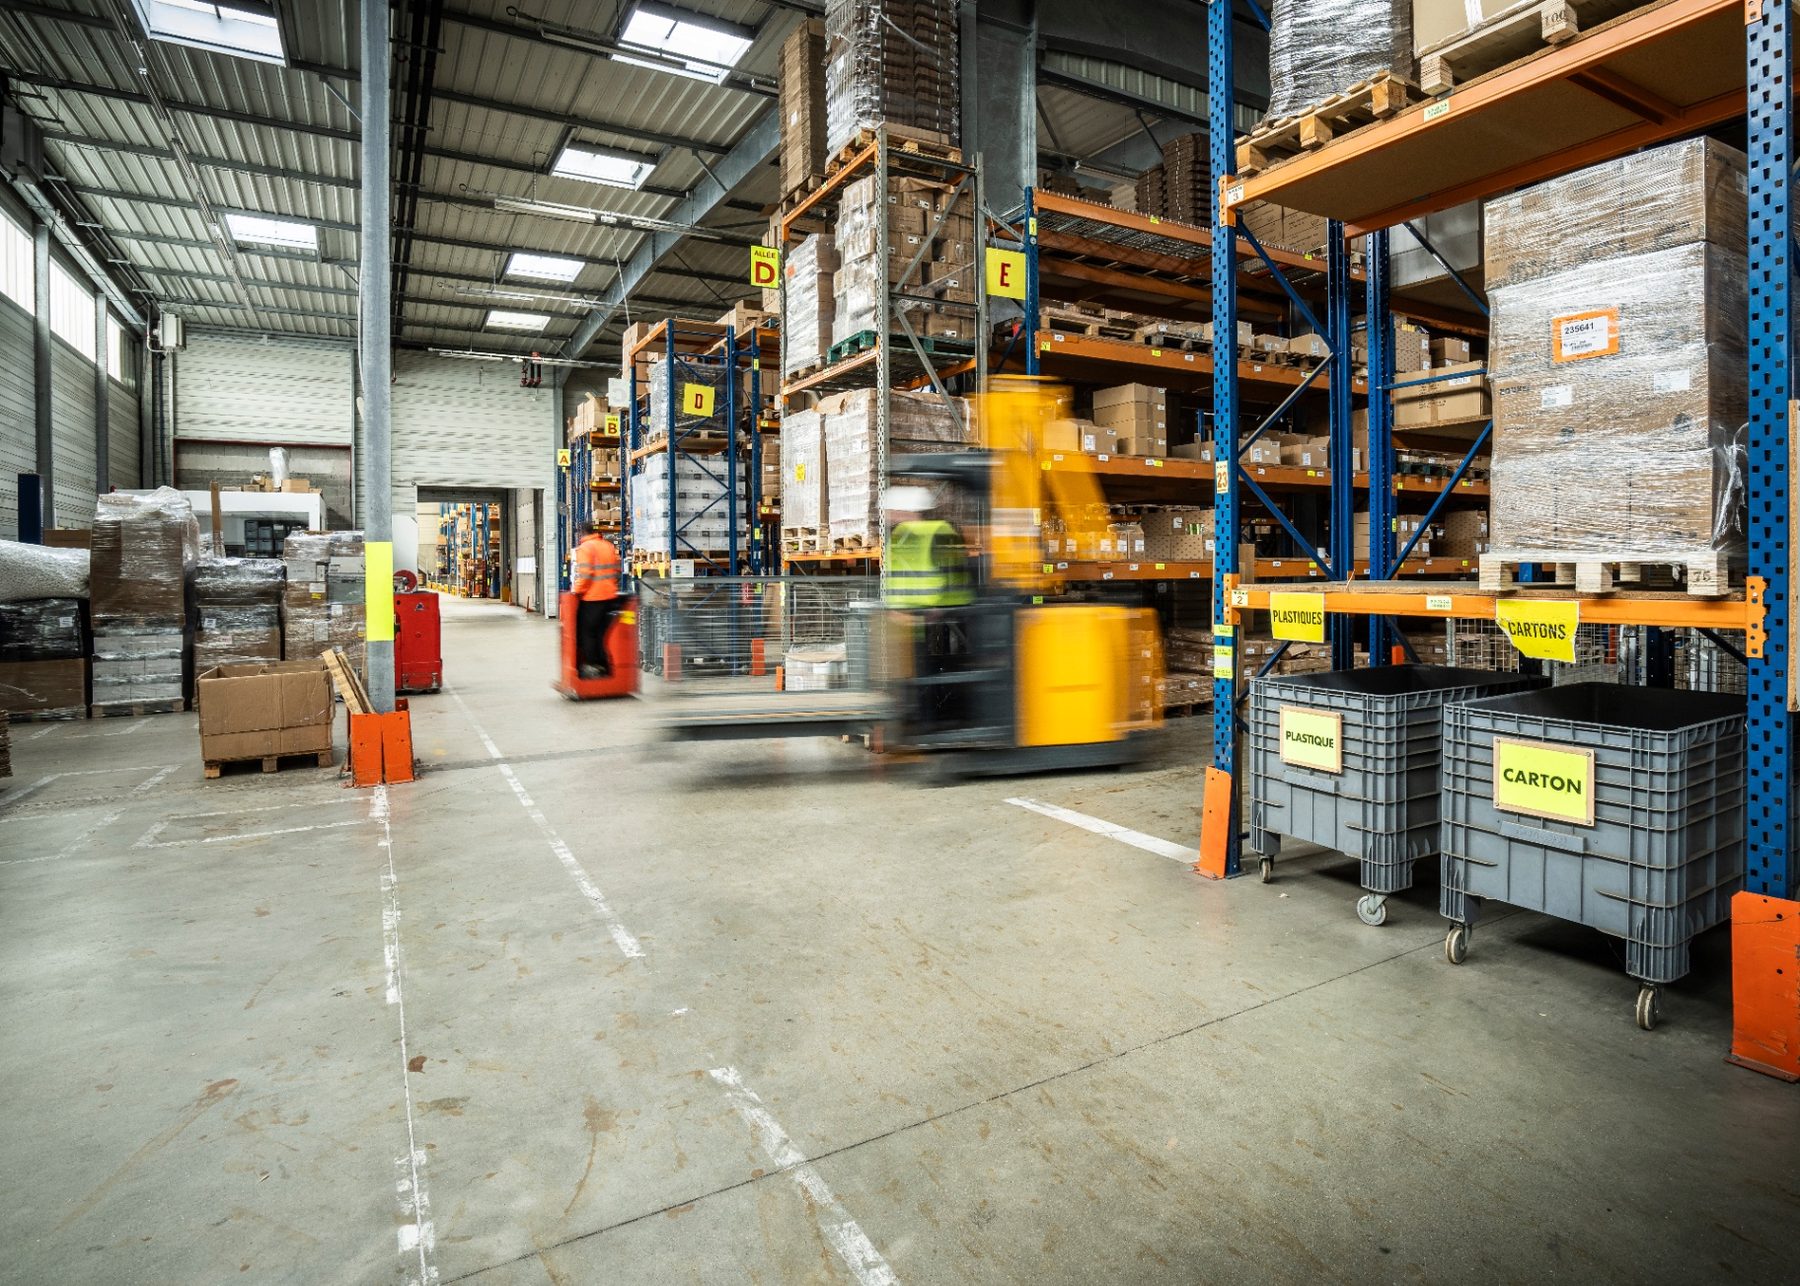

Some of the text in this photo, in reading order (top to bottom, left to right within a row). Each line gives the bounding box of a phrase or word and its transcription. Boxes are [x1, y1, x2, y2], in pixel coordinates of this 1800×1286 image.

[755, 261, 775, 284] D
[1000, 262, 1011, 287] E
[1564, 322, 1594, 335] 235641
[695, 393, 703, 410] D
[608, 422, 618, 434] B
[560, 455, 569, 464] A
[1217, 471, 1228, 488] 23
[1237, 595, 1244, 605] 2
[1272, 609, 1323, 625] PLASTIQUES
[1507, 621, 1567, 640] CARTONS
[1285, 730, 1335, 749] PLASTIQUE
[1503, 767, 1582, 795] CARTON
